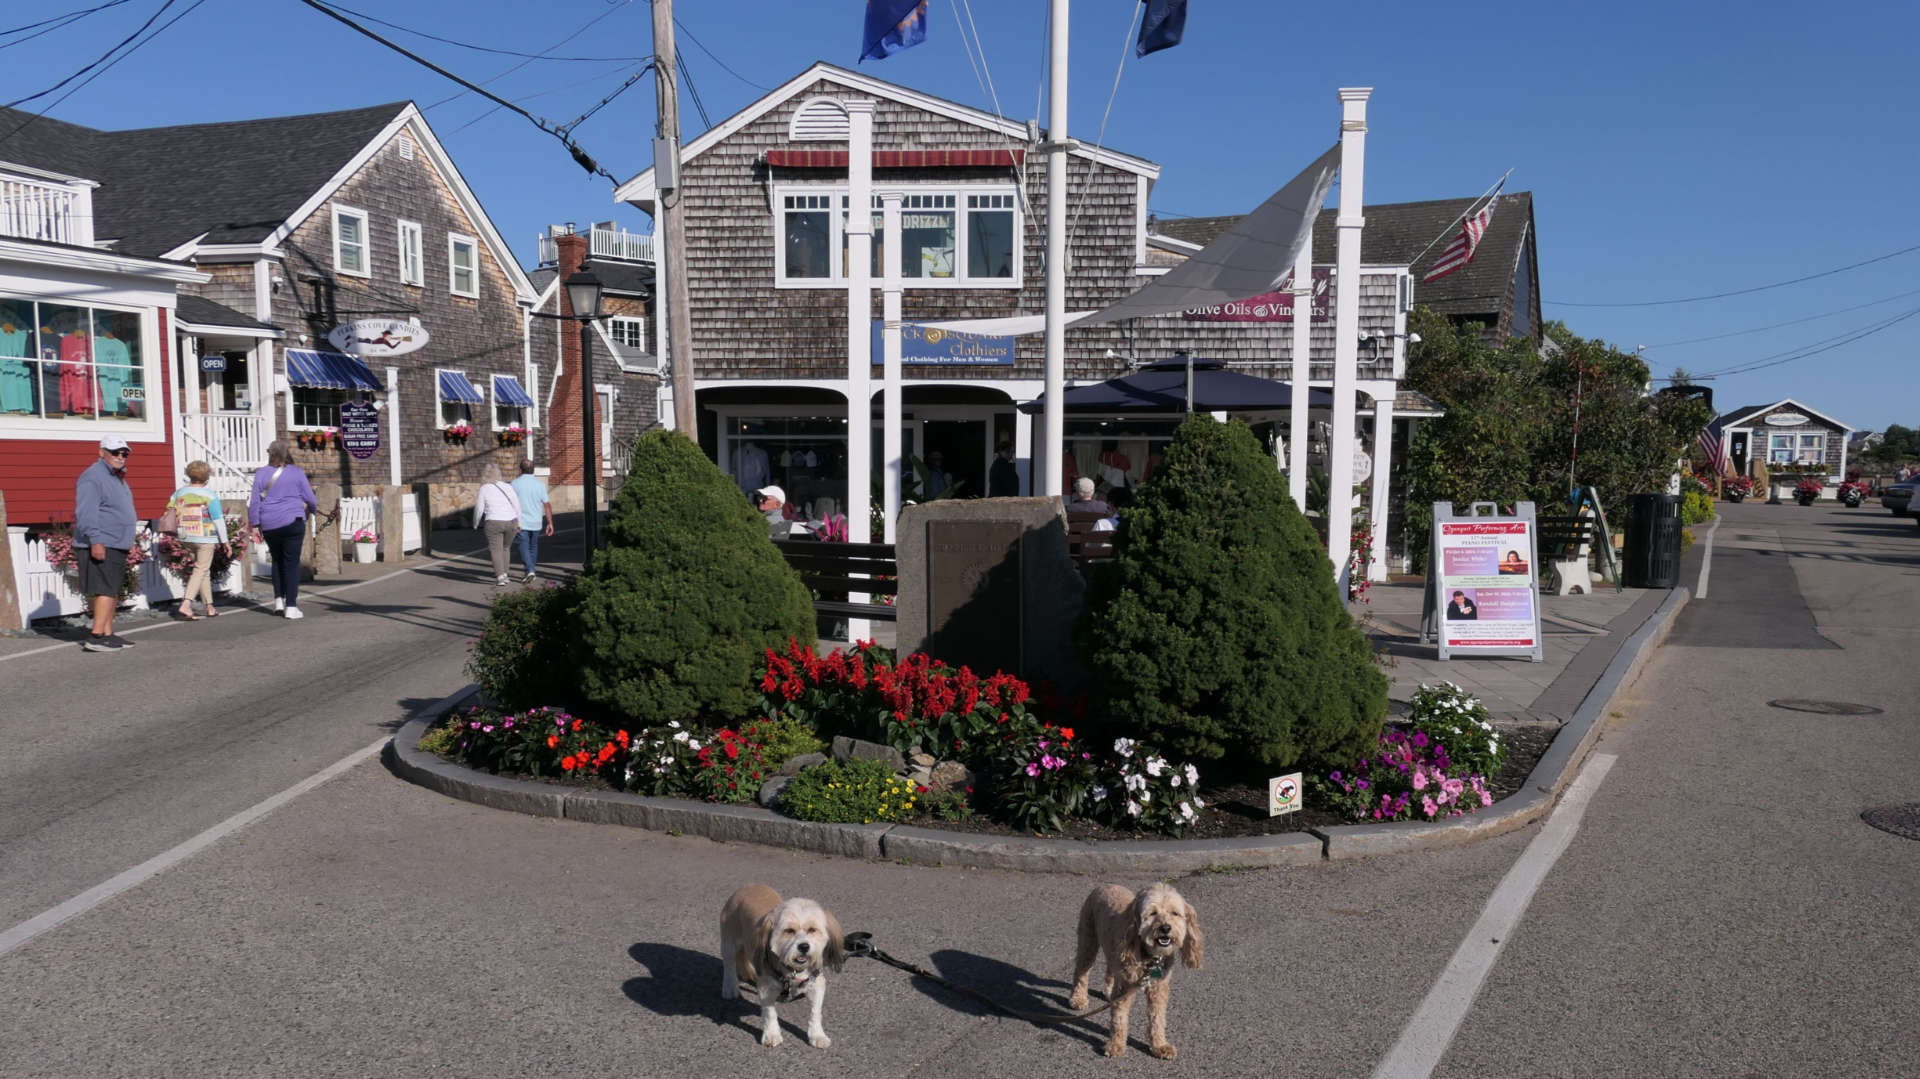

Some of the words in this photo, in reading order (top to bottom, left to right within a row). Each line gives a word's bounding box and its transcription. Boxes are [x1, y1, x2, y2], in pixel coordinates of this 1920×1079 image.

[1224, 302, 1251, 315] Oils
[1268, 303, 1325, 316] Vinrs
[950, 341, 1007, 356] Clothiers
[203, 359, 224, 369] OPEN
[910, 355, 938, 363] Clothing
[122, 388, 145, 399] OPEN
[1473, 524, 1507, 534] Performing
